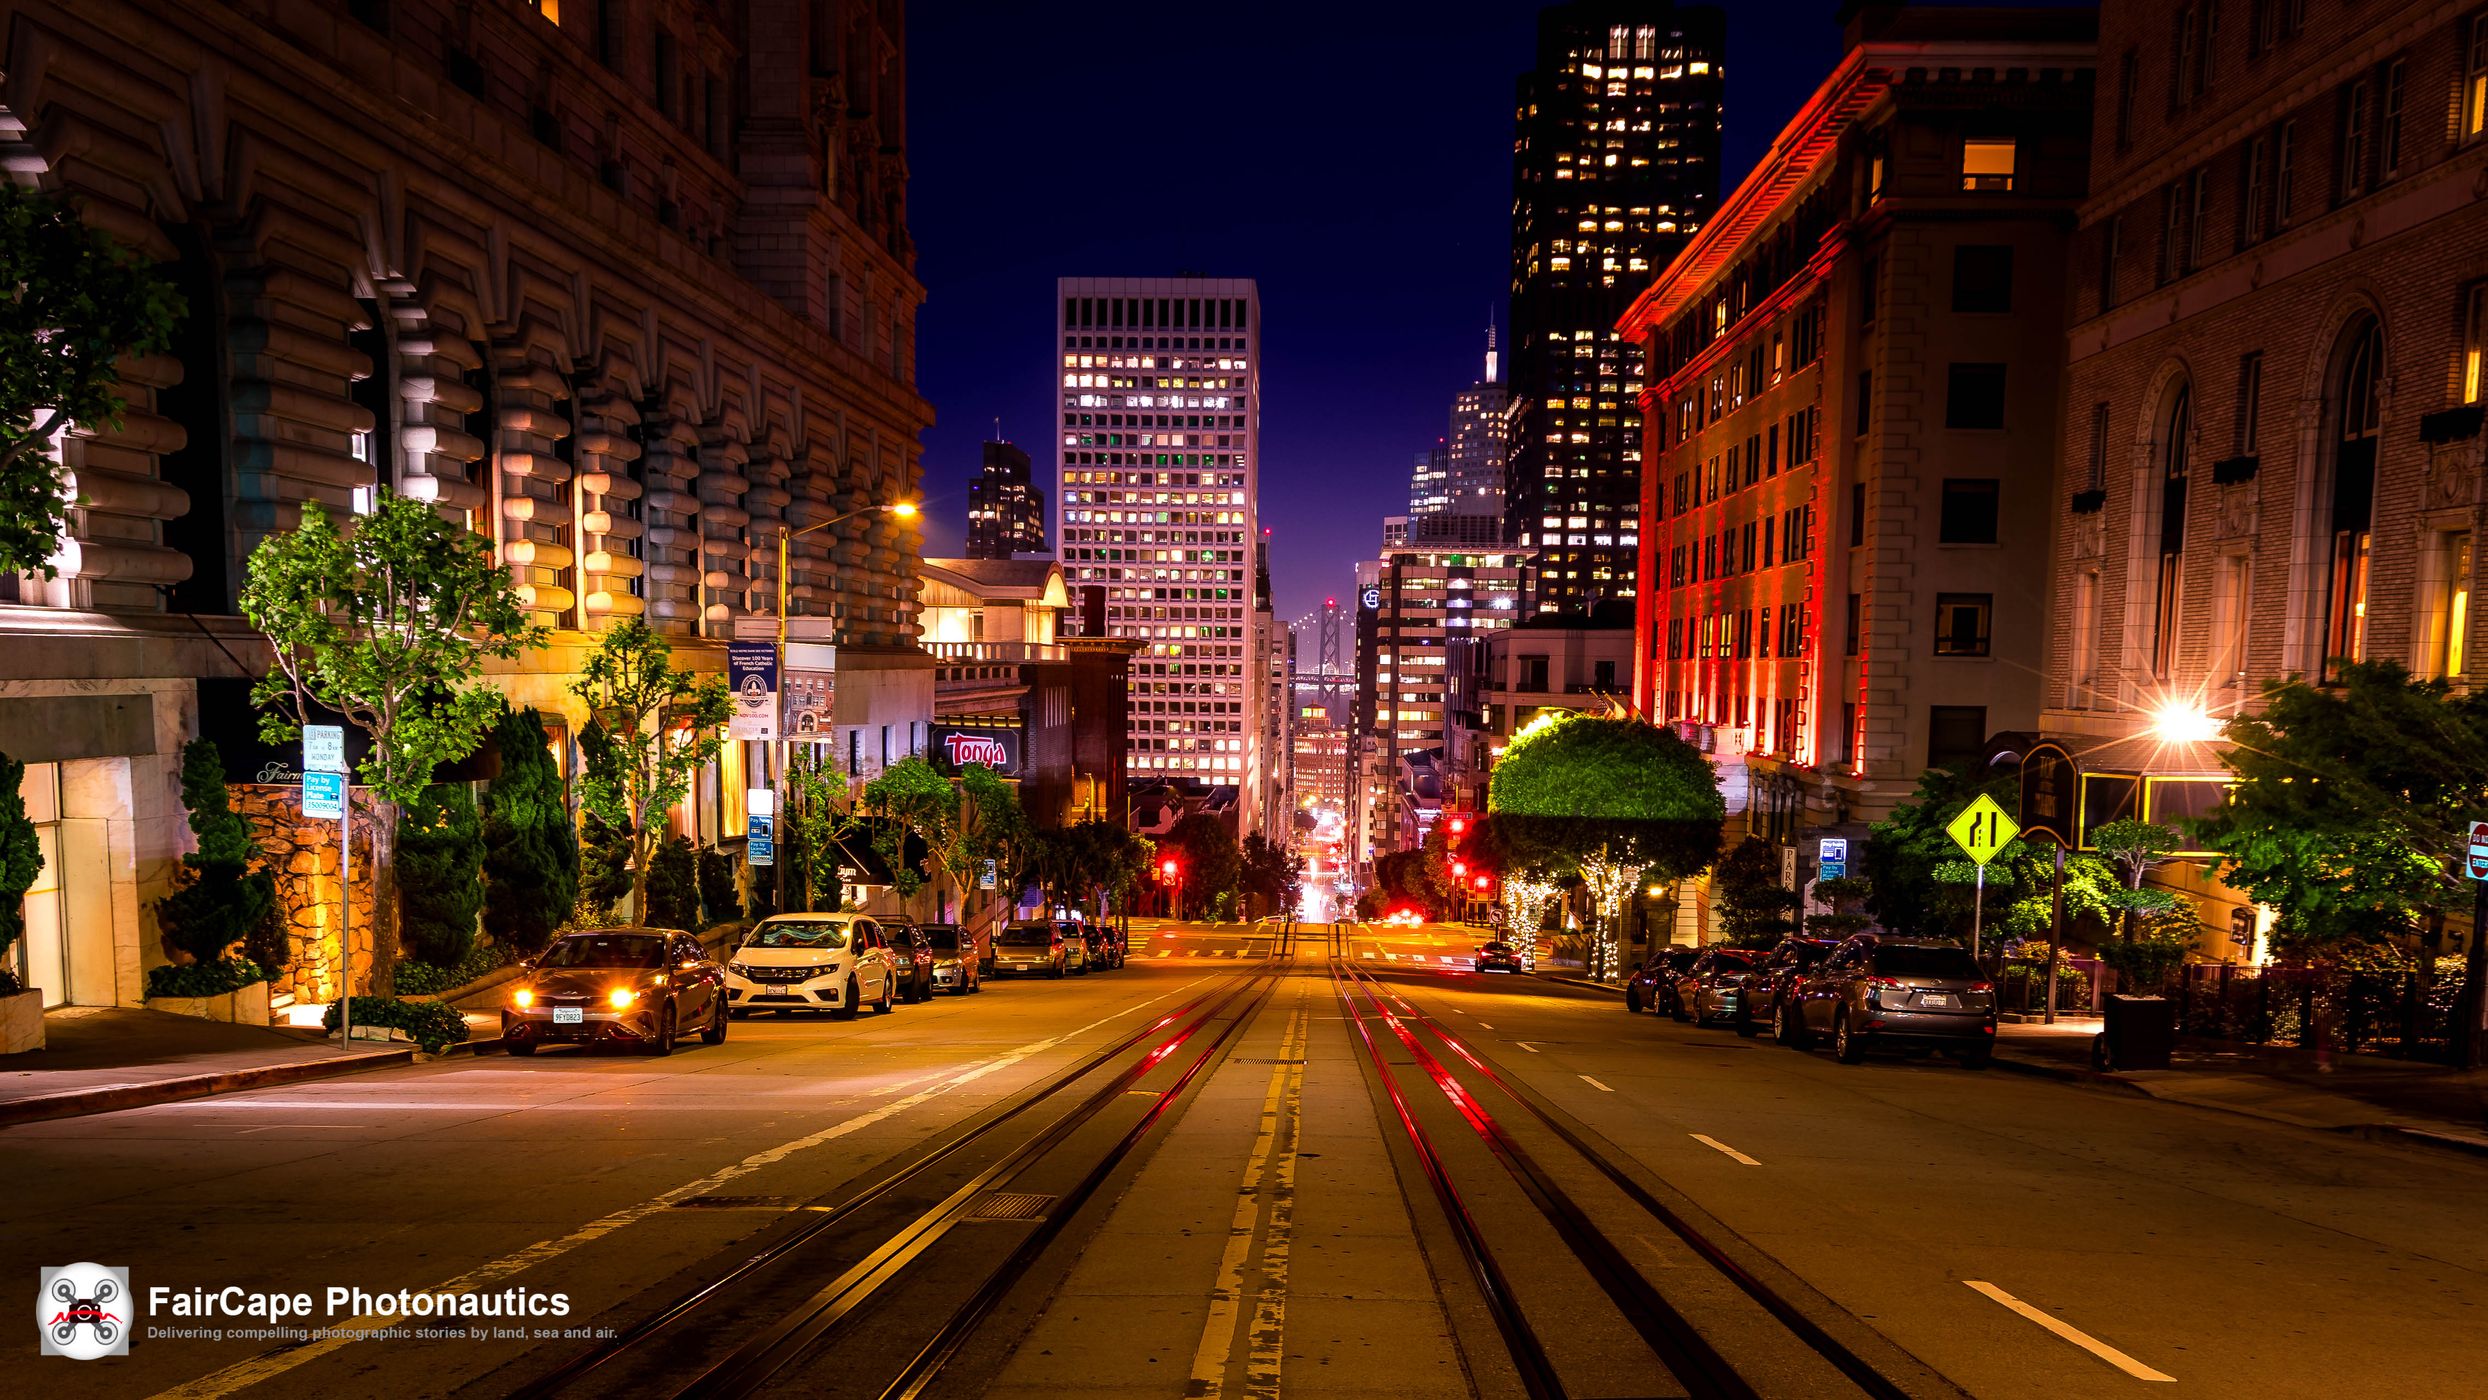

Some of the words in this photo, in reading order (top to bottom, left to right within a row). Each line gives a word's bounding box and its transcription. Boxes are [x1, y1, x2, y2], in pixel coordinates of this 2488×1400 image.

[944, 731, 1006, 769] Tonga
[311, 753, 335, 761] MONDAY
[307, 775, 319, 785] Pay
[320, 775, 331, 786] by
[307, 783, 333, 793] License
